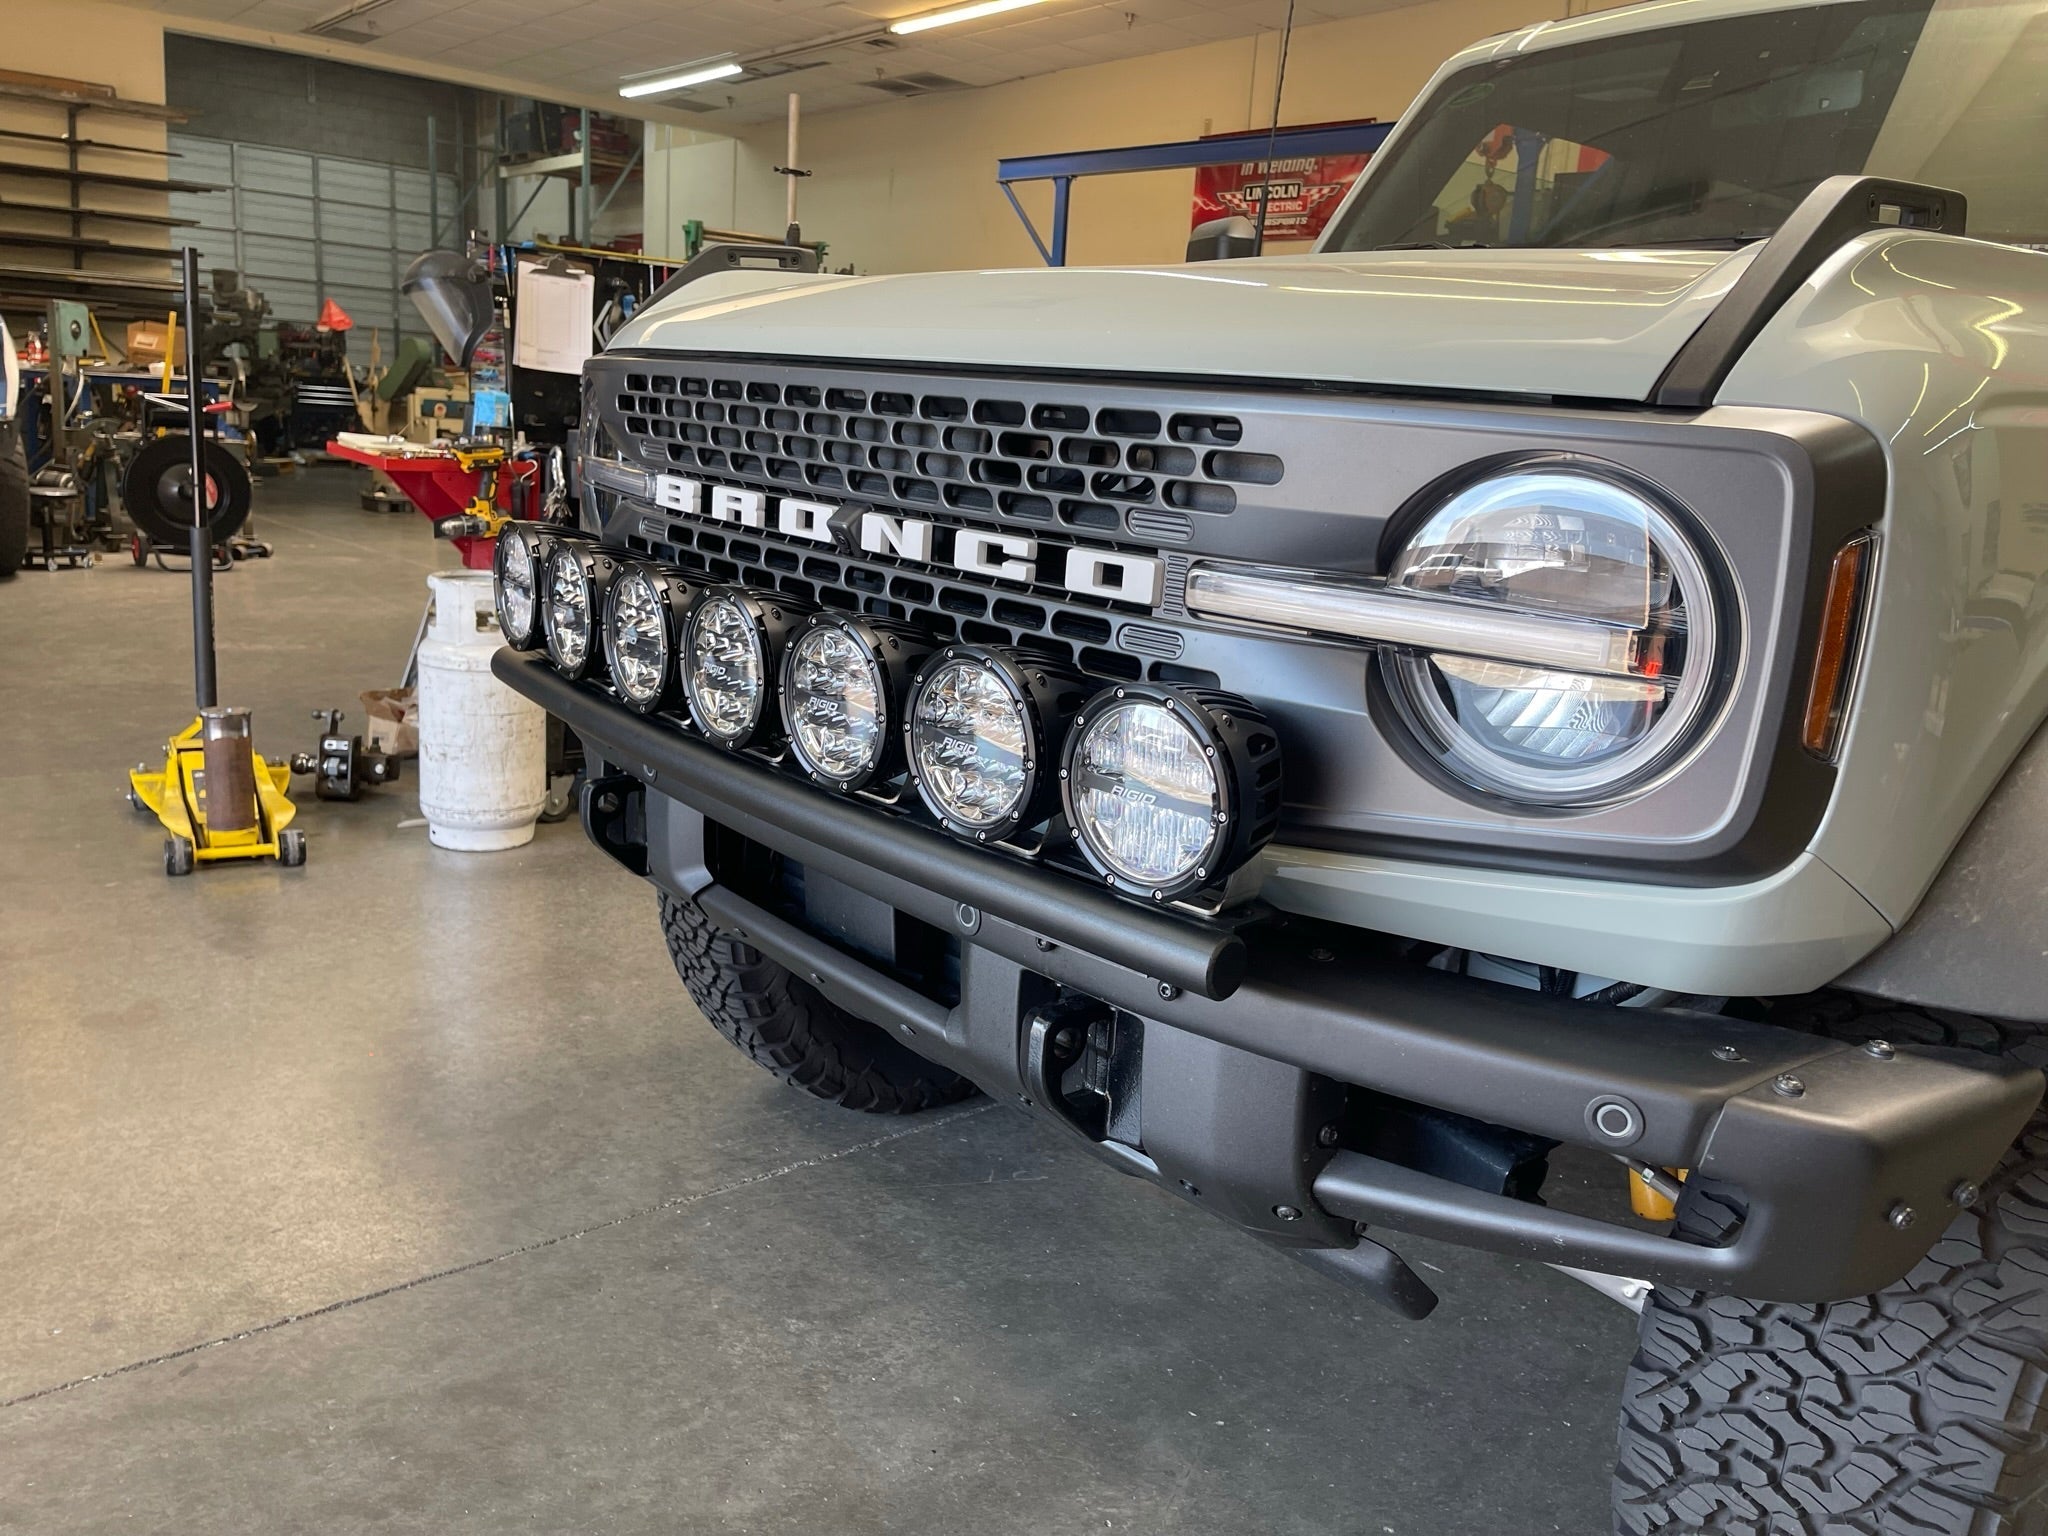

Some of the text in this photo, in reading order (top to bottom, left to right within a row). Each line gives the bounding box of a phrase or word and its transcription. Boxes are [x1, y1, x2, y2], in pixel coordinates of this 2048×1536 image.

[1245, 185, 1298, 200] LINCOLN
[1256, 201, 1303, 212] EECTRIC
[655, 473, 1162, 605] BRONCO
[809, 696, 838, 711] RIGID
[943, 736, 978, 755] RIGID
[1111, 785, 1156, 804] RIGID
